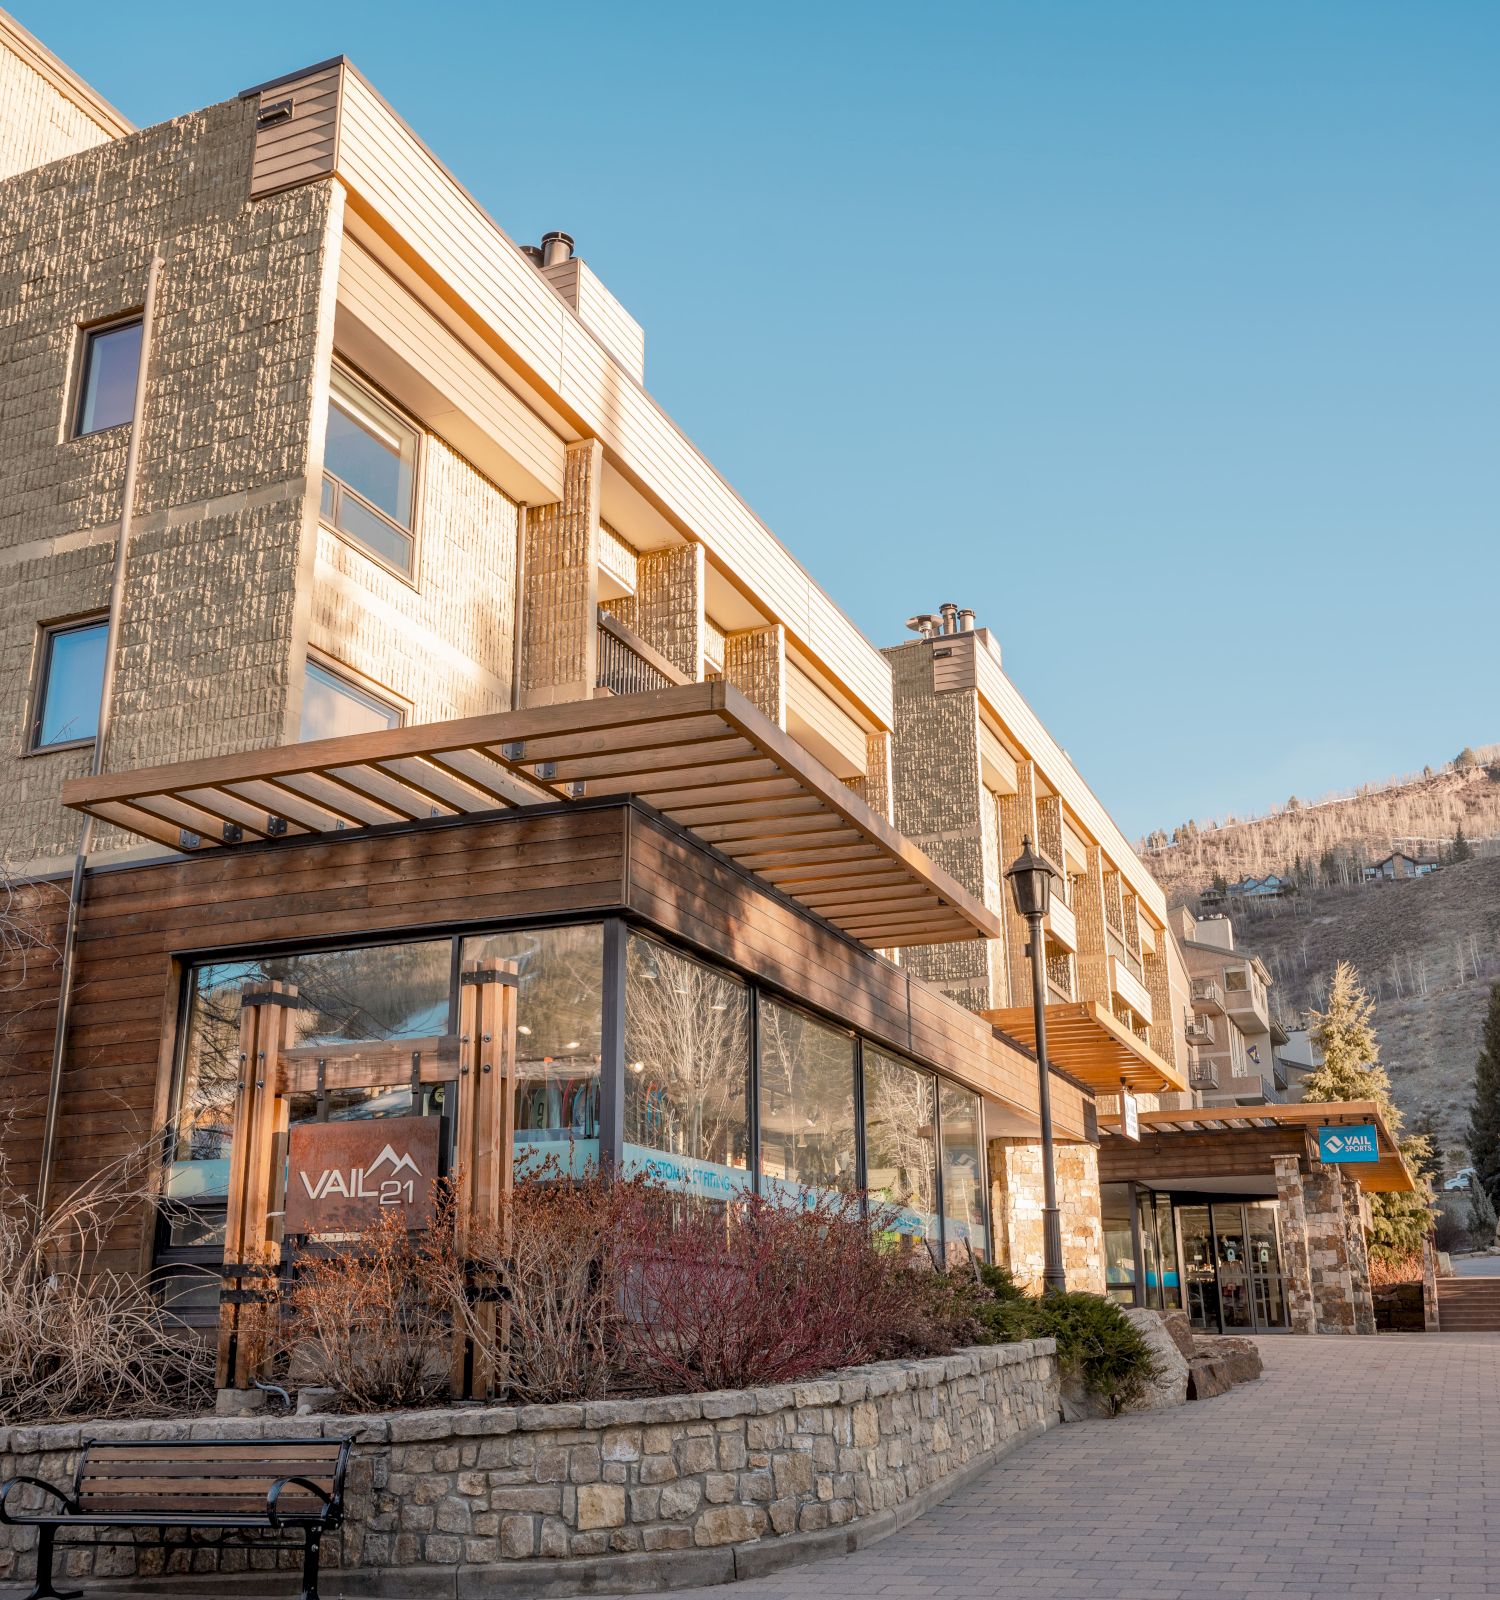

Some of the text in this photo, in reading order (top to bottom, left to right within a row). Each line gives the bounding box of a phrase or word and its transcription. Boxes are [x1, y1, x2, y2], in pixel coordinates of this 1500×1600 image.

[1343, 1135, 1371, 1145] VAIL
[299, 1167, 415, 1205] VAIL 21
